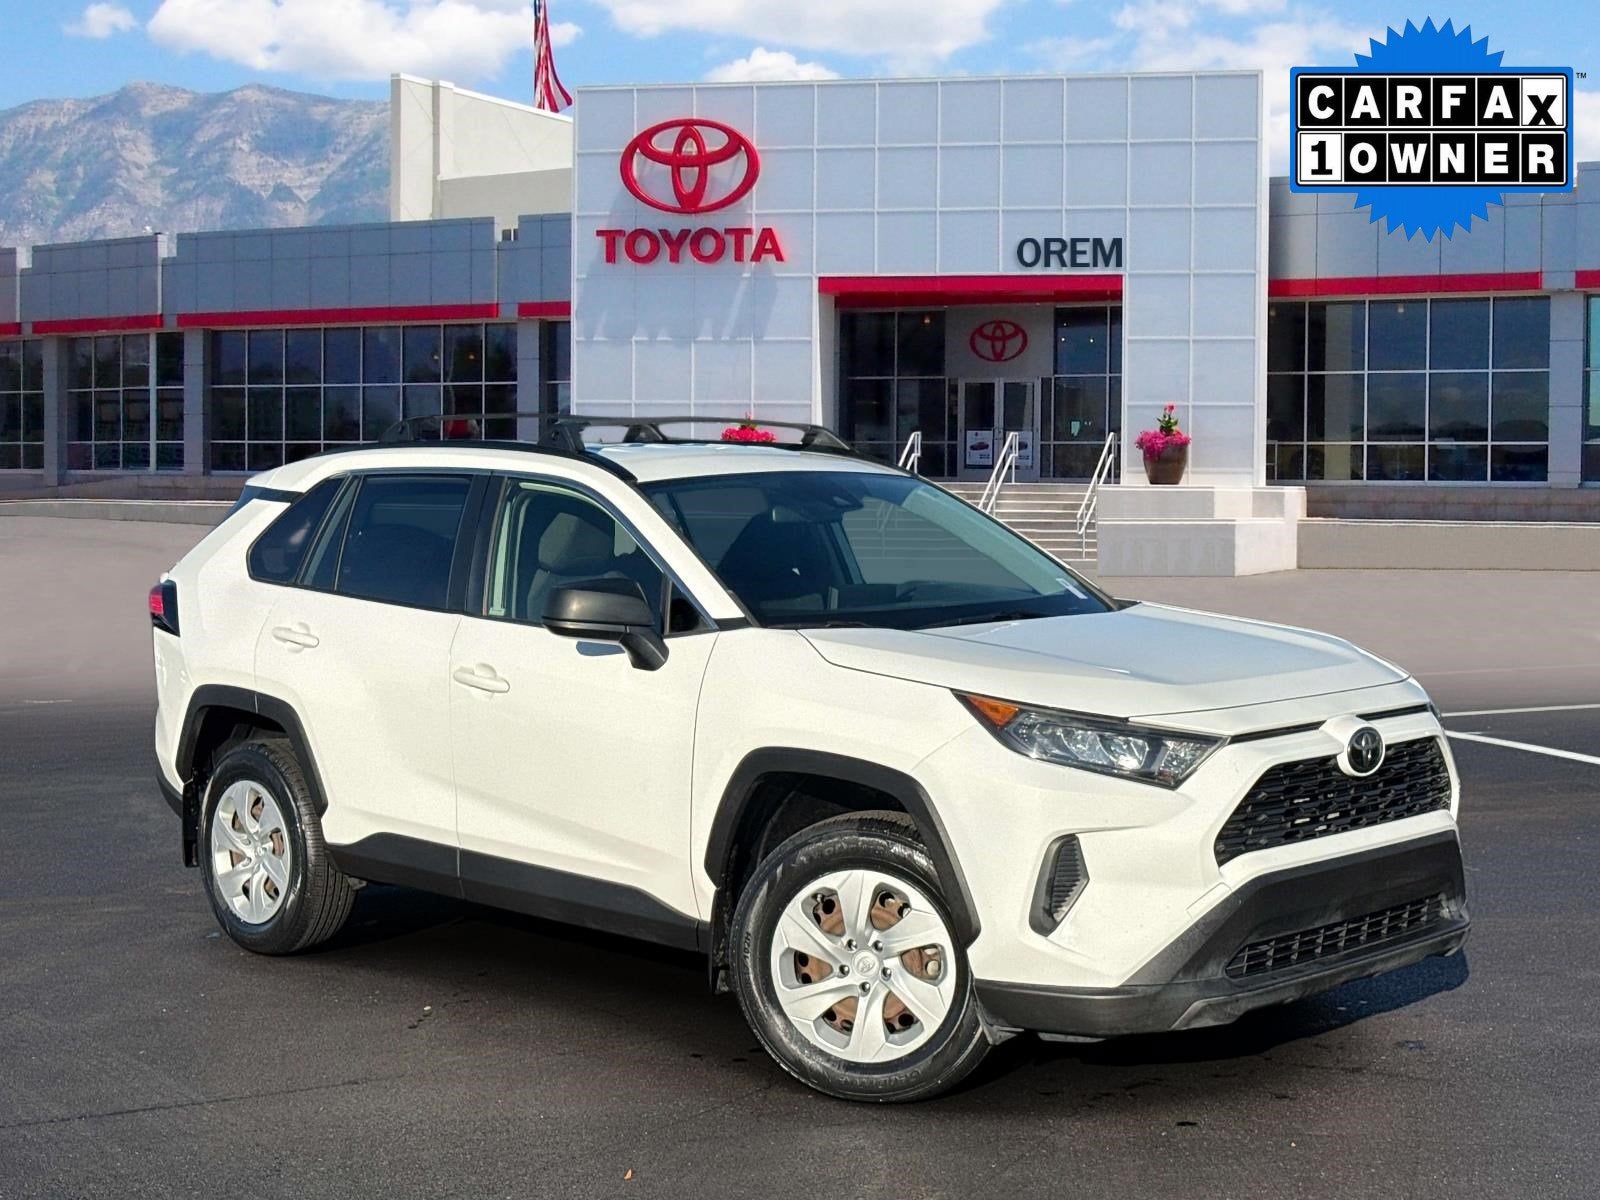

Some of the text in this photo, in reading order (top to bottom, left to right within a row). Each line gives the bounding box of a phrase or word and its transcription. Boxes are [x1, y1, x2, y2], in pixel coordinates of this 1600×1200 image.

[595, 227, 785, 265] TOYOTA
[1017, 237, 1123, 268] OREM
[743, 931, 751, 960] 102H
